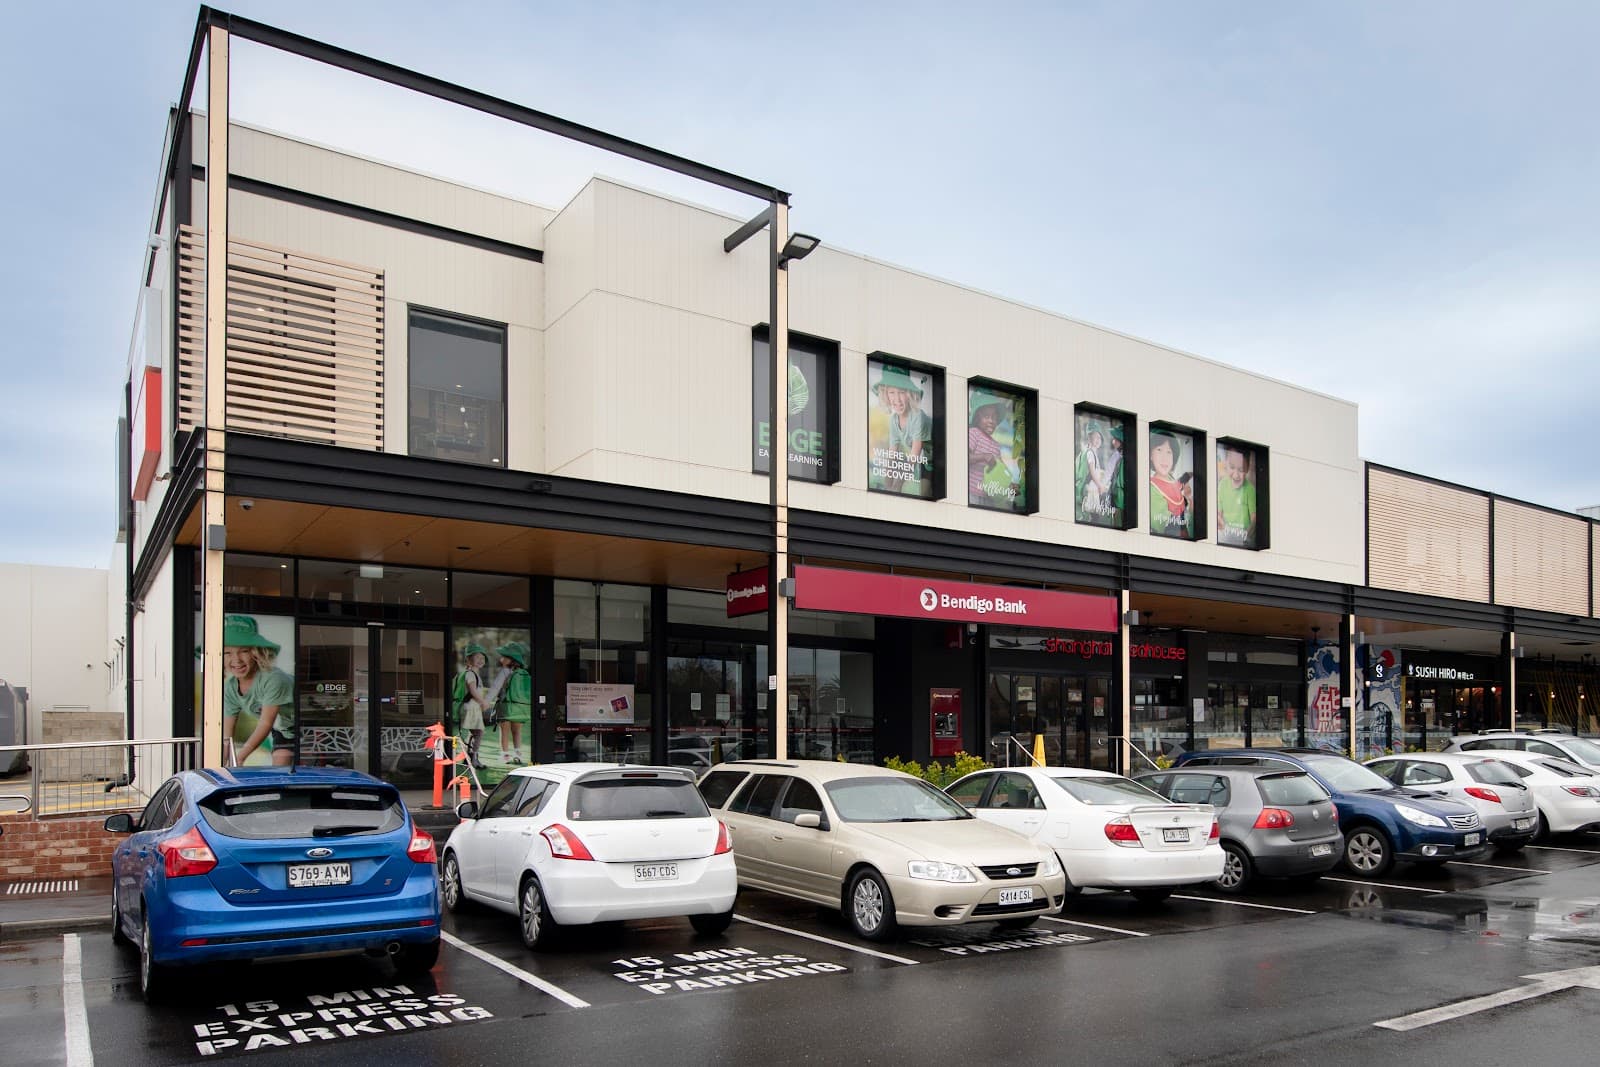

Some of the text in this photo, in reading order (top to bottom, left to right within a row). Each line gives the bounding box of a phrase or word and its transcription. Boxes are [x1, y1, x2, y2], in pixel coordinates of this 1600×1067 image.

[759, 421, 823, 456] EGE
[788, 453, 823, 467] EARNING
[873, 448, 928, 465] WHERE YOUR
[873, 457, 915, 472] CHILDREN
[941, 594, 1027, 614] Bendigo Bank
[1129, 641, 1186, 660] eahouse
[1415, 666, 1457, 680] SUSHI HIRO
[325, 684, 347, 692] EDGE
[612, 947, 758, 968] 15 MIN
[613, 954, 808, 983] EXPRESS
[638, 962, 848, 995] PARKING
[216, 985, 415, 1017] 15 MIN
[193, 994, 466, 1038] EXPRESS
[195, 1006, 494, 1056] PARKING
